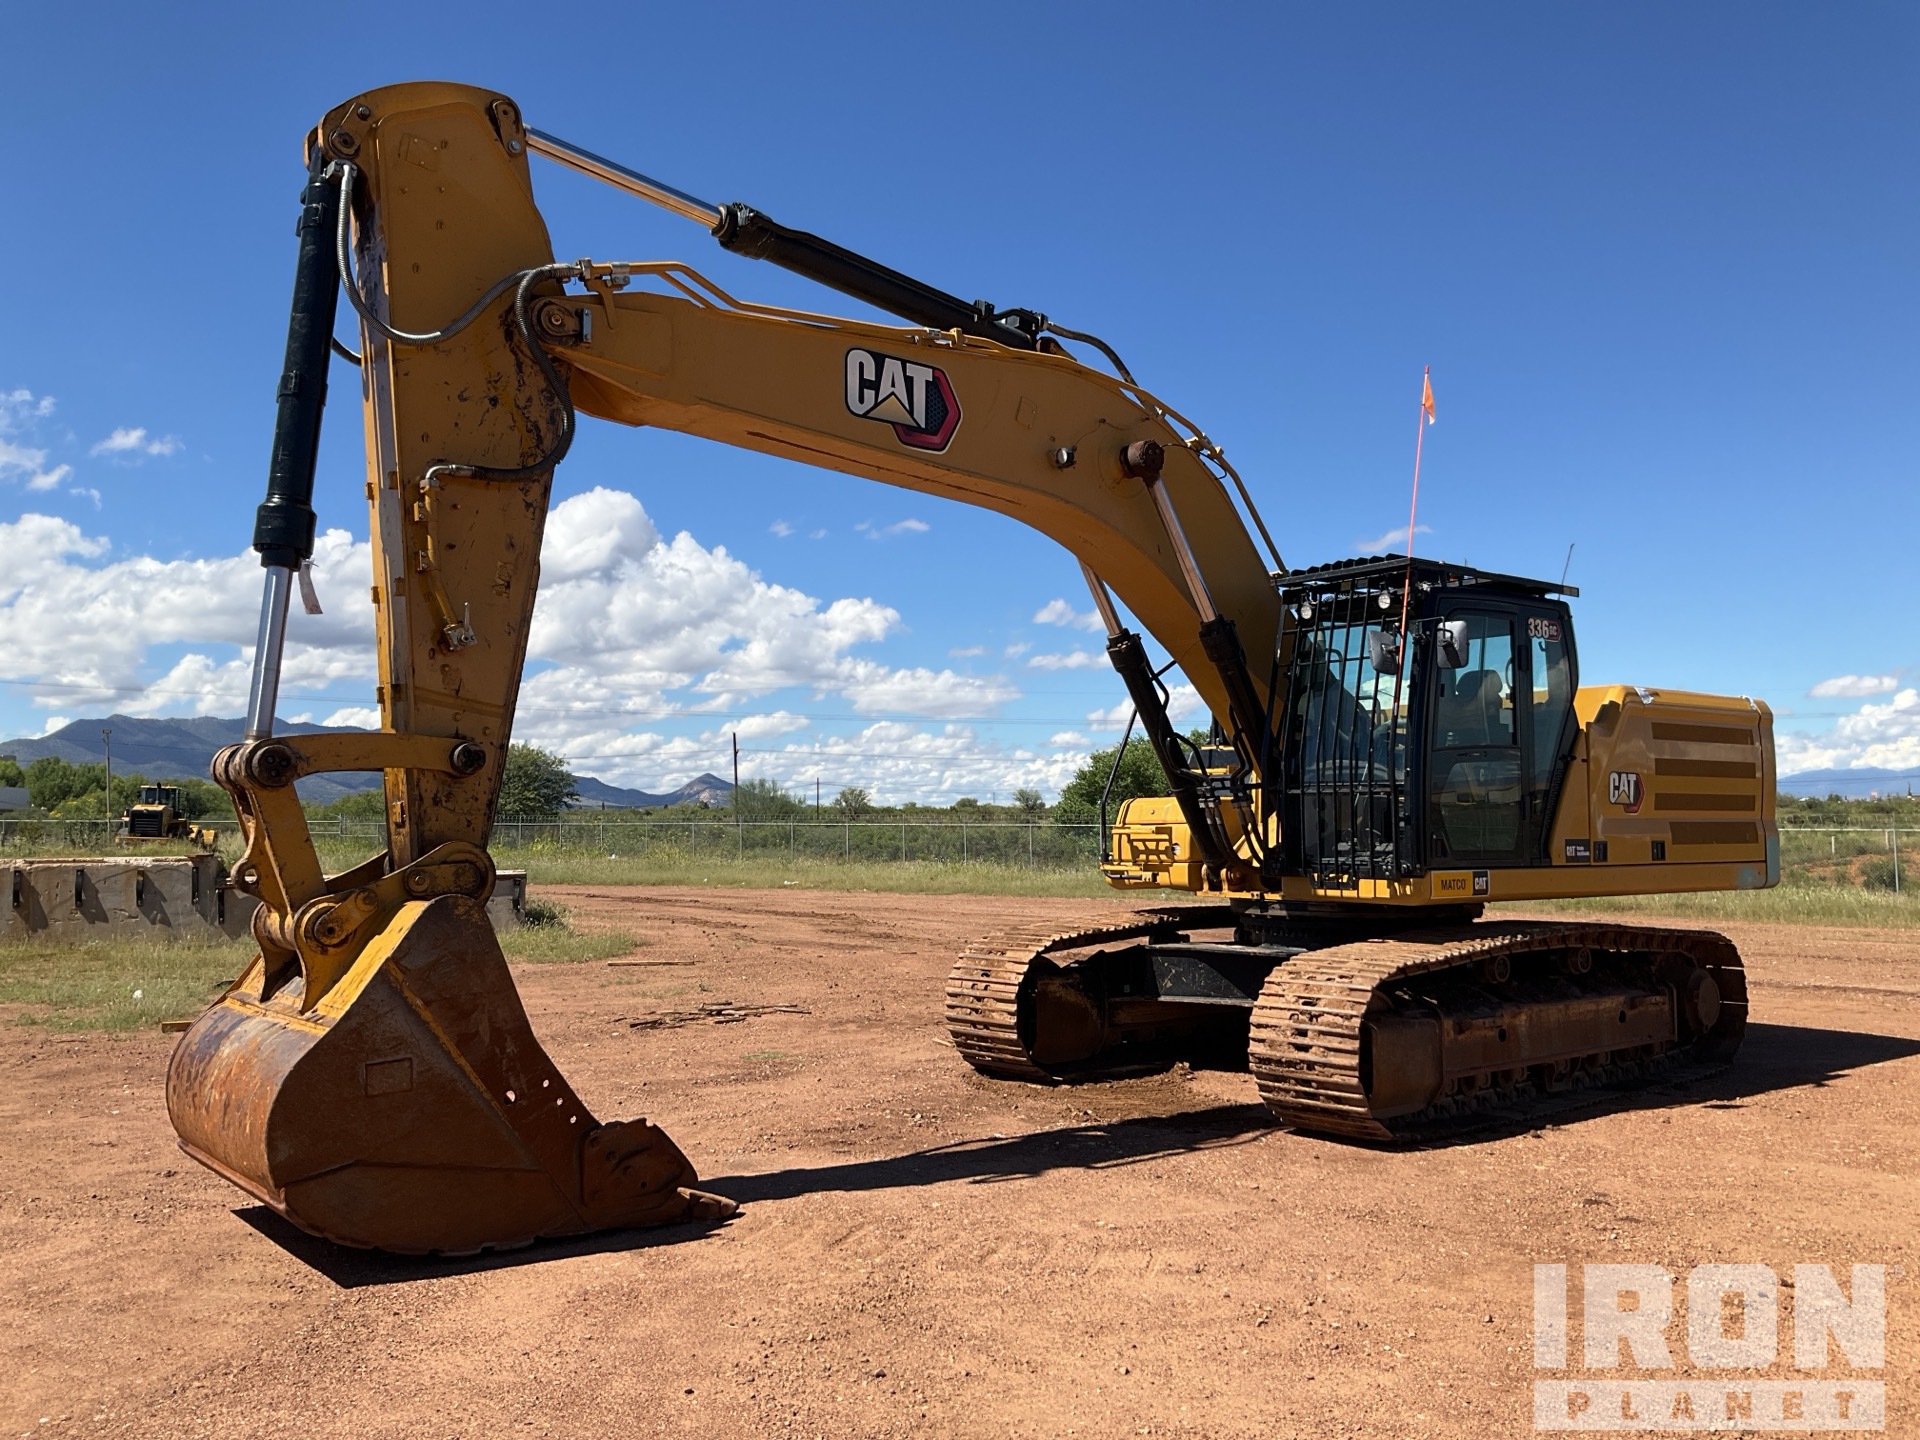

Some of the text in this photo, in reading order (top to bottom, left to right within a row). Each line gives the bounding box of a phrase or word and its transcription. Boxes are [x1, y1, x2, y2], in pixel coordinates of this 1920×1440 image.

[847, 349, 933, 429] CAT
[1528, 618, 1549, 639] 336
[1610, 772, 1637, 804] CAT
[1441, 877, 1487, 890] MATCO CAT
